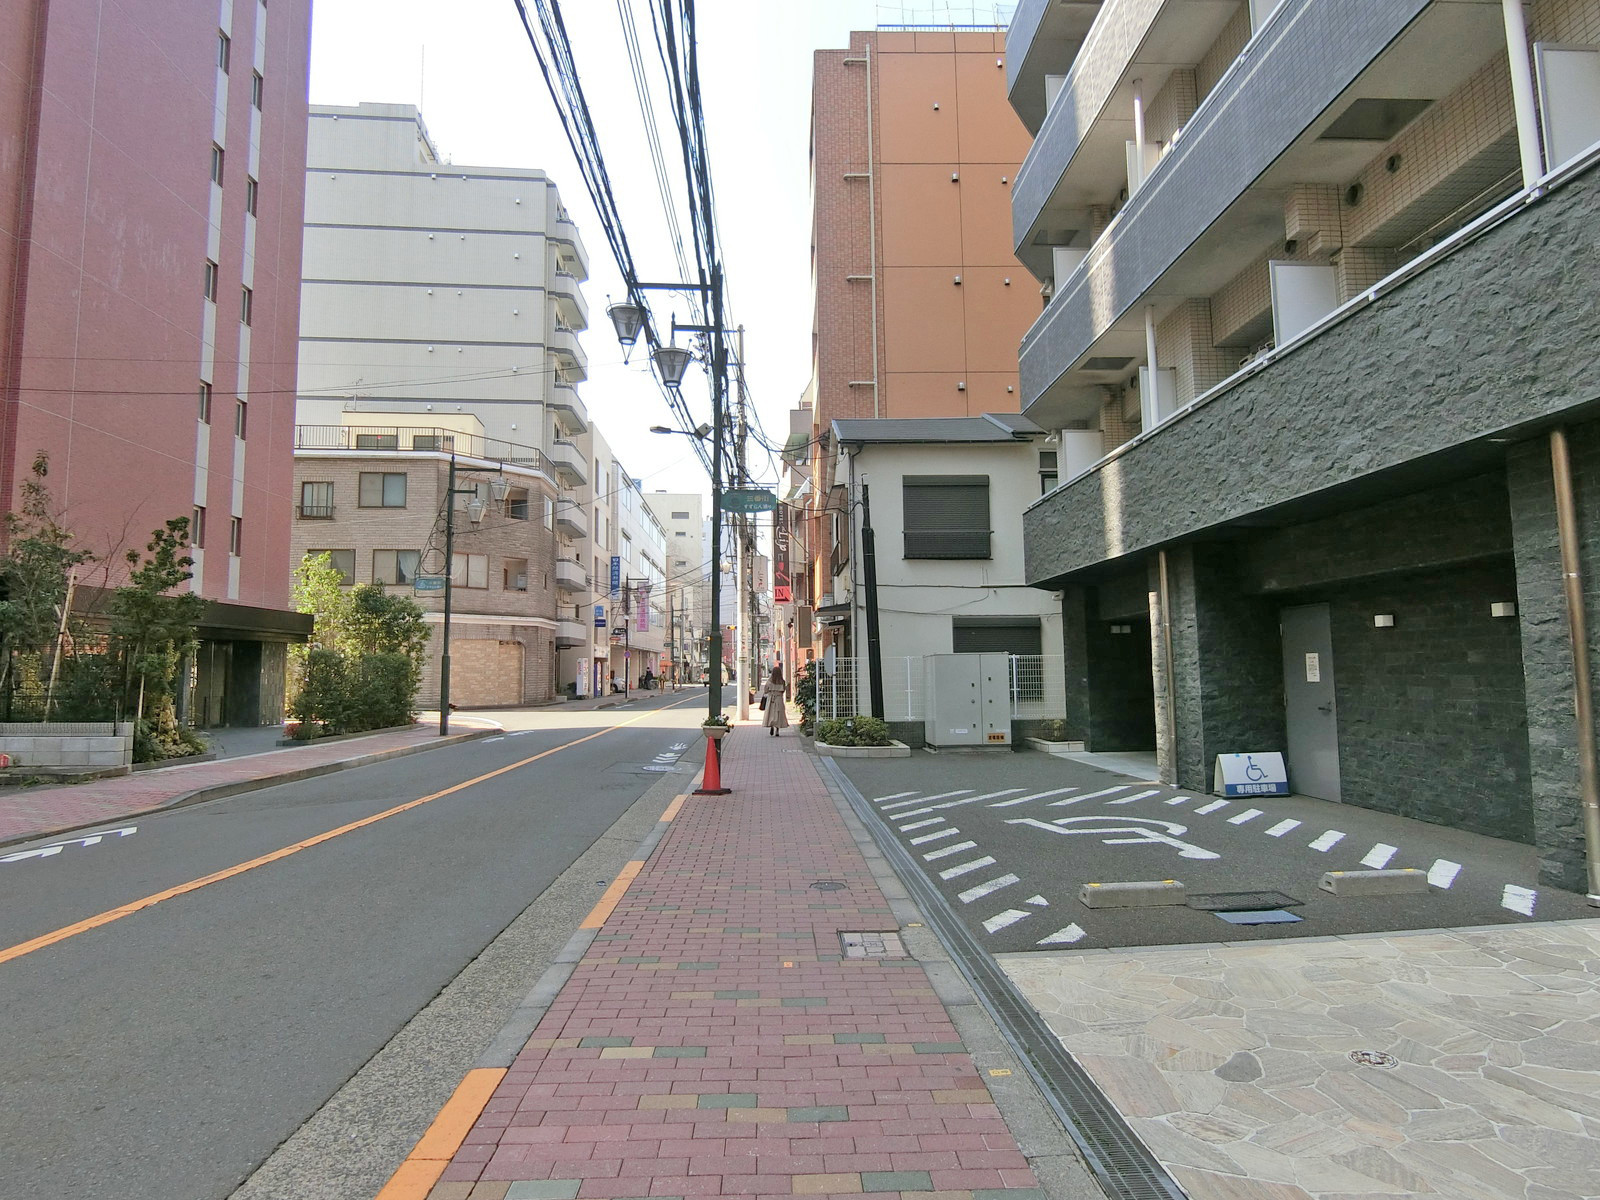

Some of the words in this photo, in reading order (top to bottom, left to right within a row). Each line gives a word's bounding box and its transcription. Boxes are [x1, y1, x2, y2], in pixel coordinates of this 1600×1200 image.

[774, 588, 784, 598] IN
[1236, 783, 1277, 794] 専用駐車場
